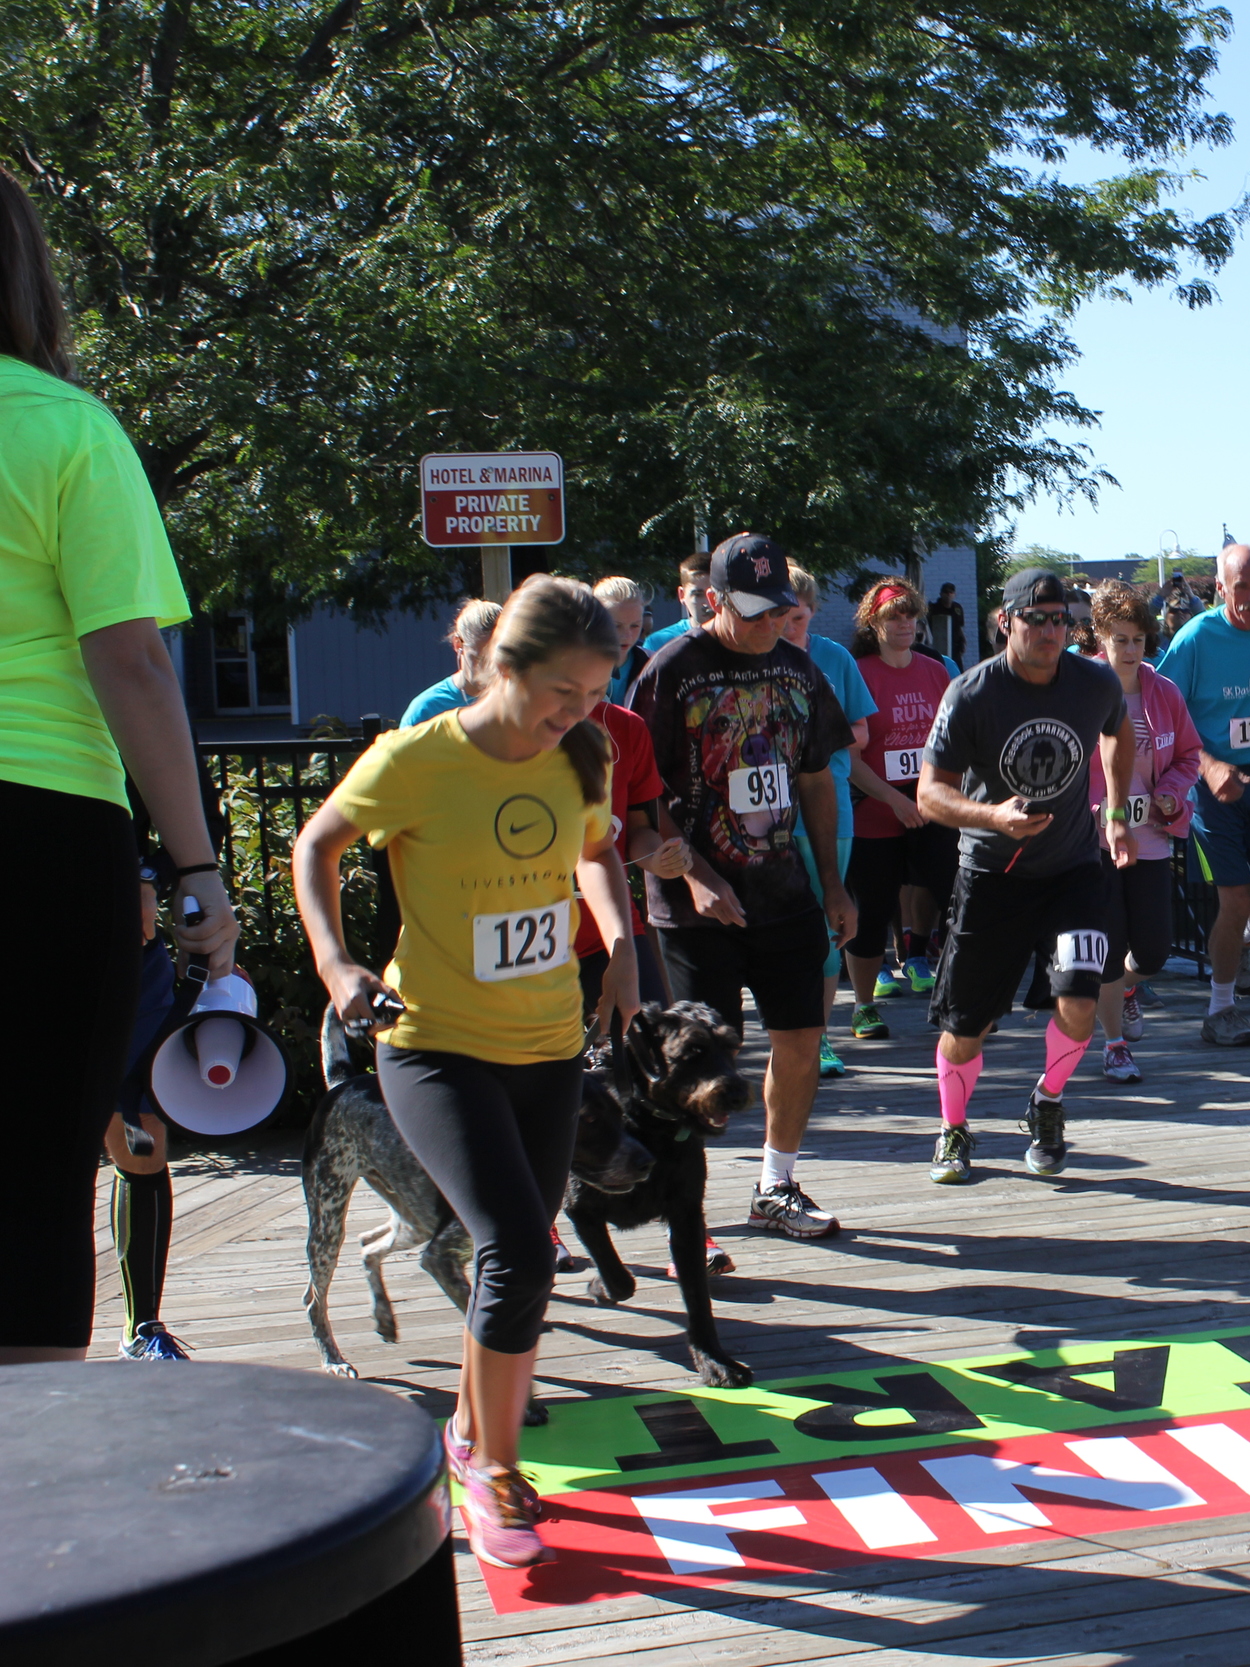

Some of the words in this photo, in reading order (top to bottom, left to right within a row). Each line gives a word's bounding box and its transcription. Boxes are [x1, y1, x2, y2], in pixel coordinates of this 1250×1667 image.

[430, 468, 475, 484] HOTEL
[480, 467, 491, 483] &
[494, 466, 553, 482] MARINA
[455, 494, 530, 513] PRIVATE
[446, 515, 541, 533] PROPERTY
[708, 670, 725, 681] ON
[895, 692, 926, 705] WILL
[891, 703, 935, 724] RUN
[1035, 723, 1071, 743] SPARTAN
[689, 741, 699, 773] ONLY
[899, 751, 920, 776] 91
[747, 769, 778, 806] 93
[494, 909, 558, 971] 123
[1071, 934, 1105, 967] 110
